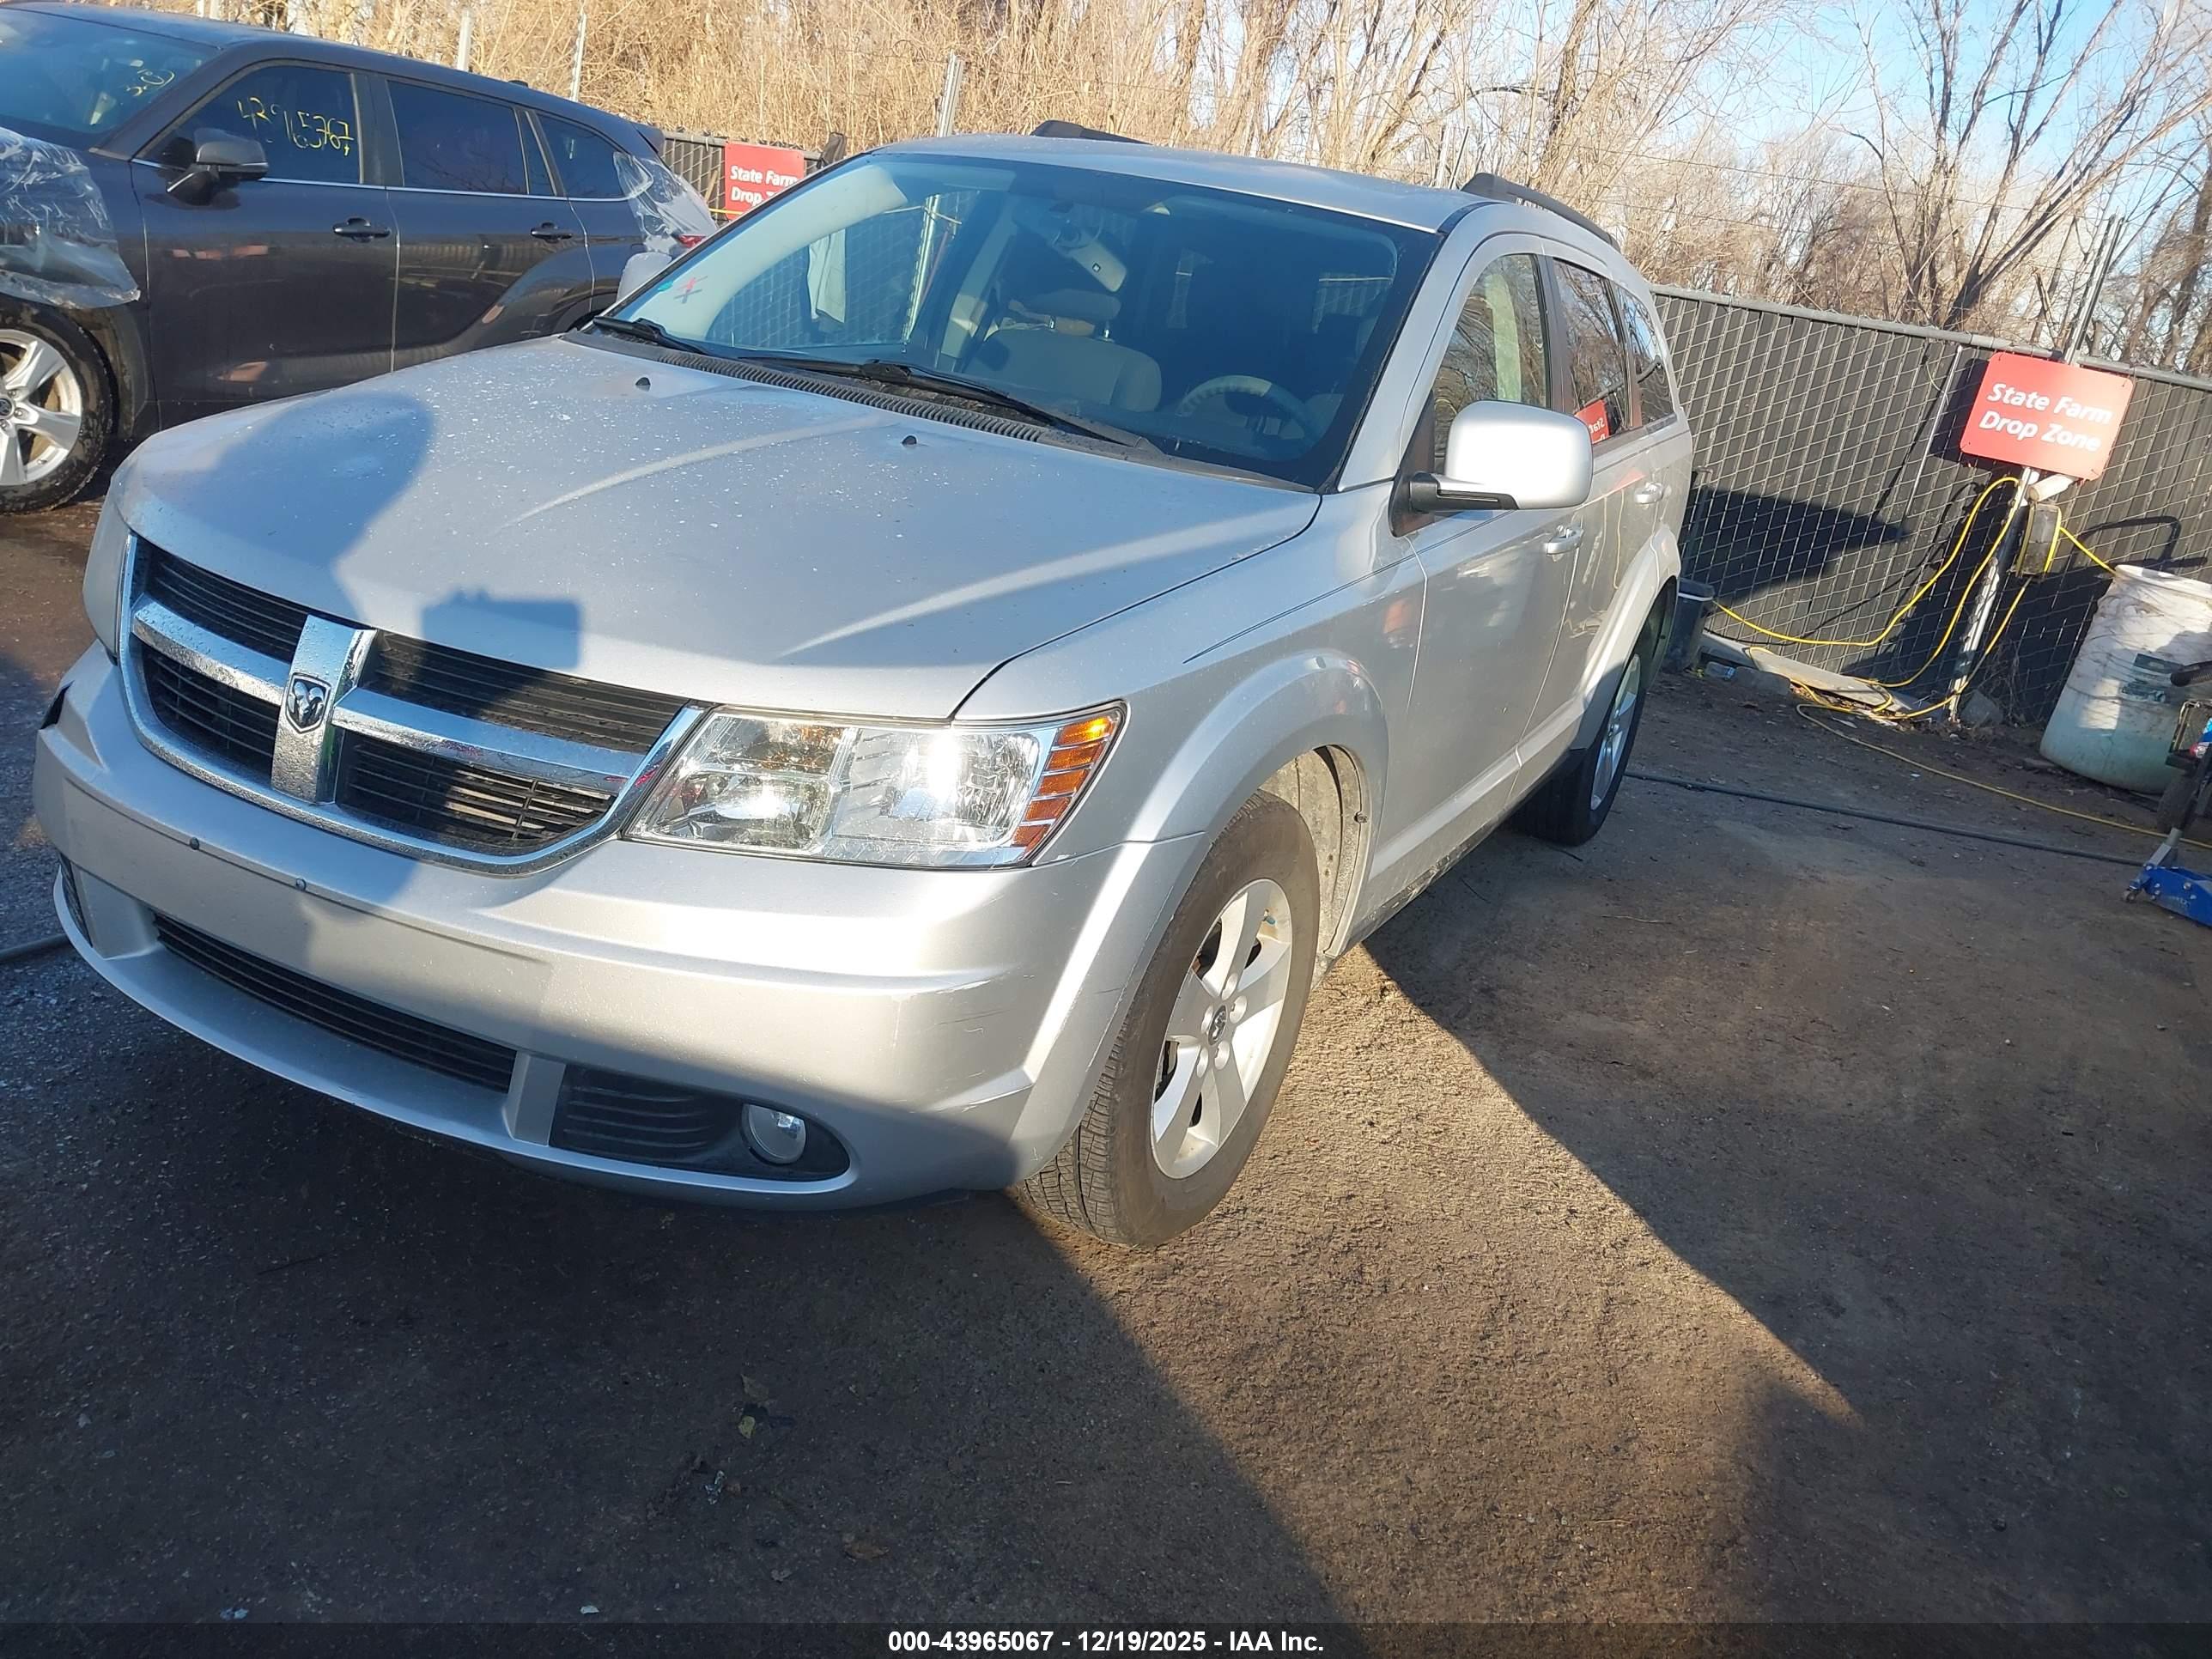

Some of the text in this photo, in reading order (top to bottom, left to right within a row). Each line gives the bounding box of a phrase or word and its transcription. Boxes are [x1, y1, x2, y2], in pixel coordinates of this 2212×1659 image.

[730, 165, 763, 184] State
[731, 186, 763, 206] Drop
[1986, 383, 2113, 425] State Farm
[1978, 410, 2102, 452] Drop Zone
